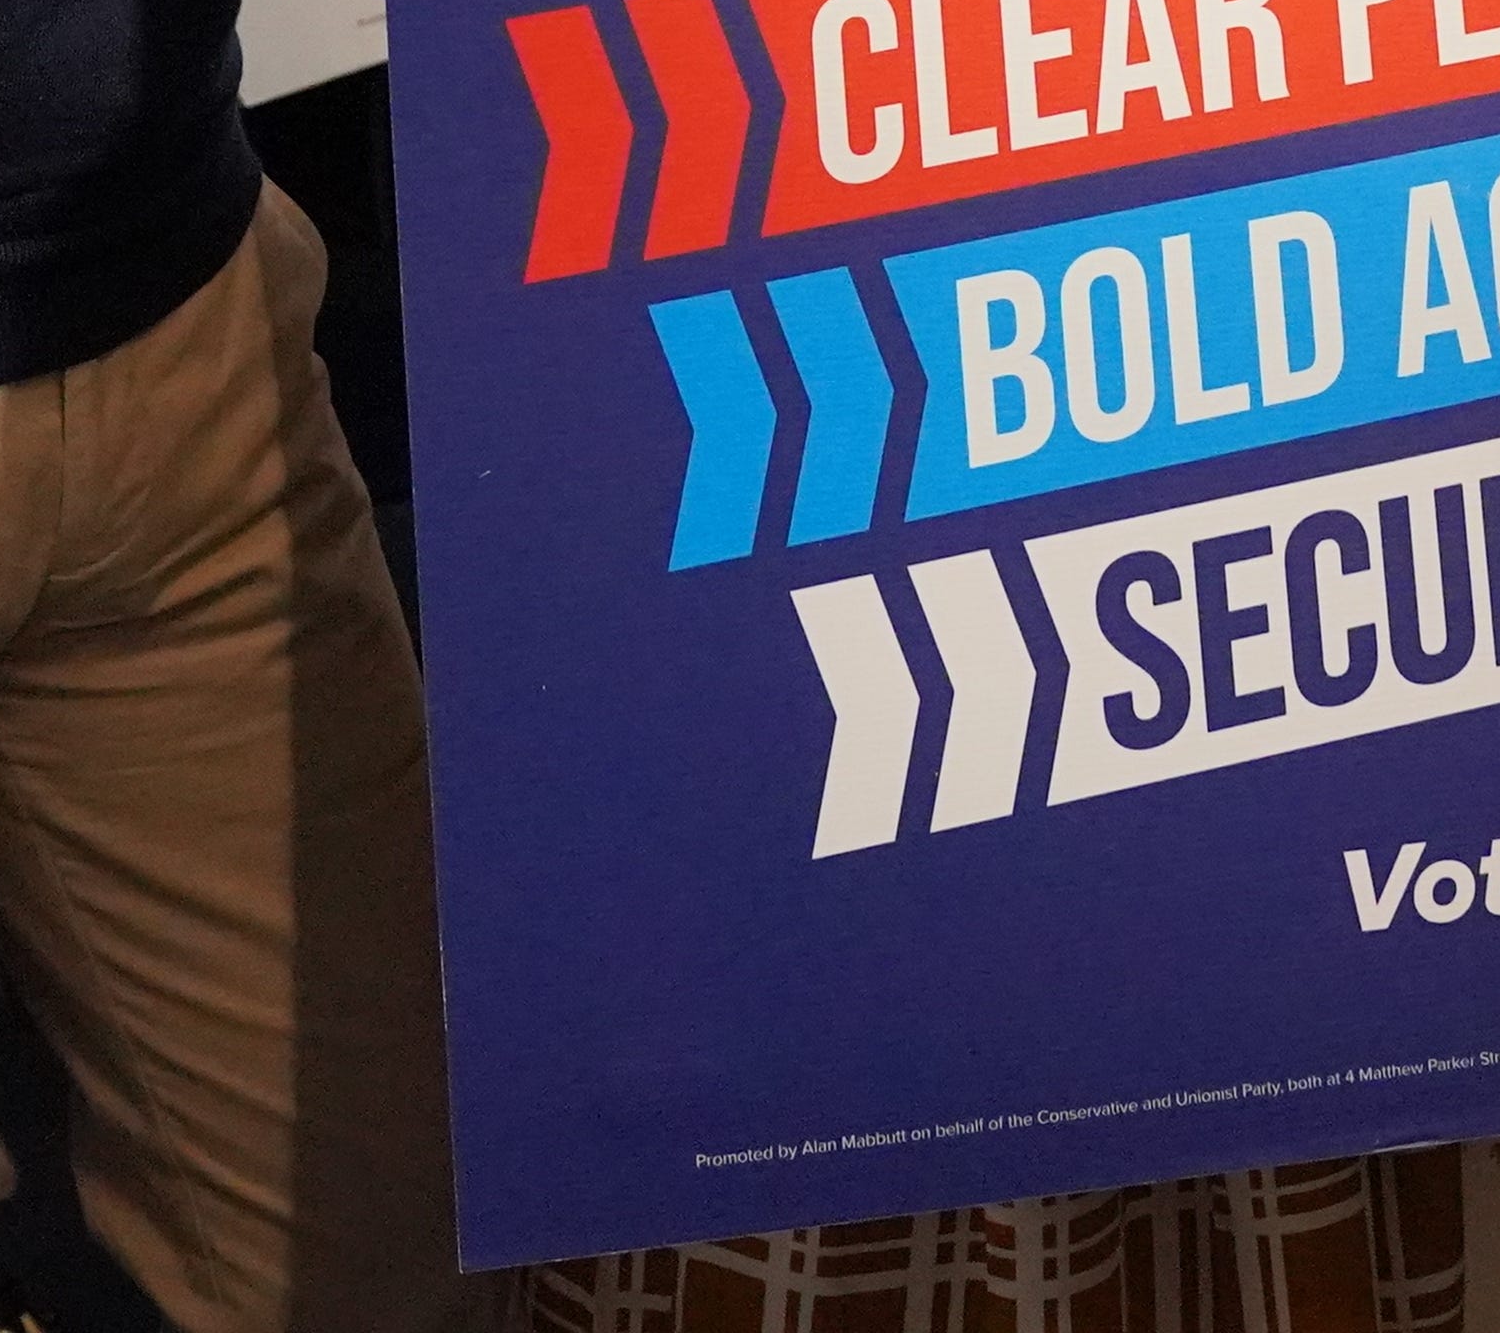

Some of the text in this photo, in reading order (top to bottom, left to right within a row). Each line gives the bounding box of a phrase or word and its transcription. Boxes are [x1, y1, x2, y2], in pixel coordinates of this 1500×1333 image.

[953, 208, 1349, 471] BOLD
[695, 1145, 774, 1169] Promoted
[778, 1143, 798, 1161] by
[802, 1139, 837, 1156] Alan
[842, 1130, 907, 1150] Mabbutt
[911, 1128, 931, 1141] on
[935, 1117, 985, 1138] behalf
[988, 1113, 1005, 1131] of
[1008, 1112, 1033, 1129] the
[1037, 1100, 1138, 1125] Conservative
[1143, 1092, 1172, 1111] and
[1176, 1084, 1238, 1107] Unionist
[1242, 1079, 1284, 1100] Party,
[1288, 1074, 1323, 1092] both
[1327, 1072, 1341, 1086] at
[1345, 1069, 1355, 1084] 4
[1359, 1063, 1424, 1083] Matthew
[1428, 1055, 1475, 1073] Parker
